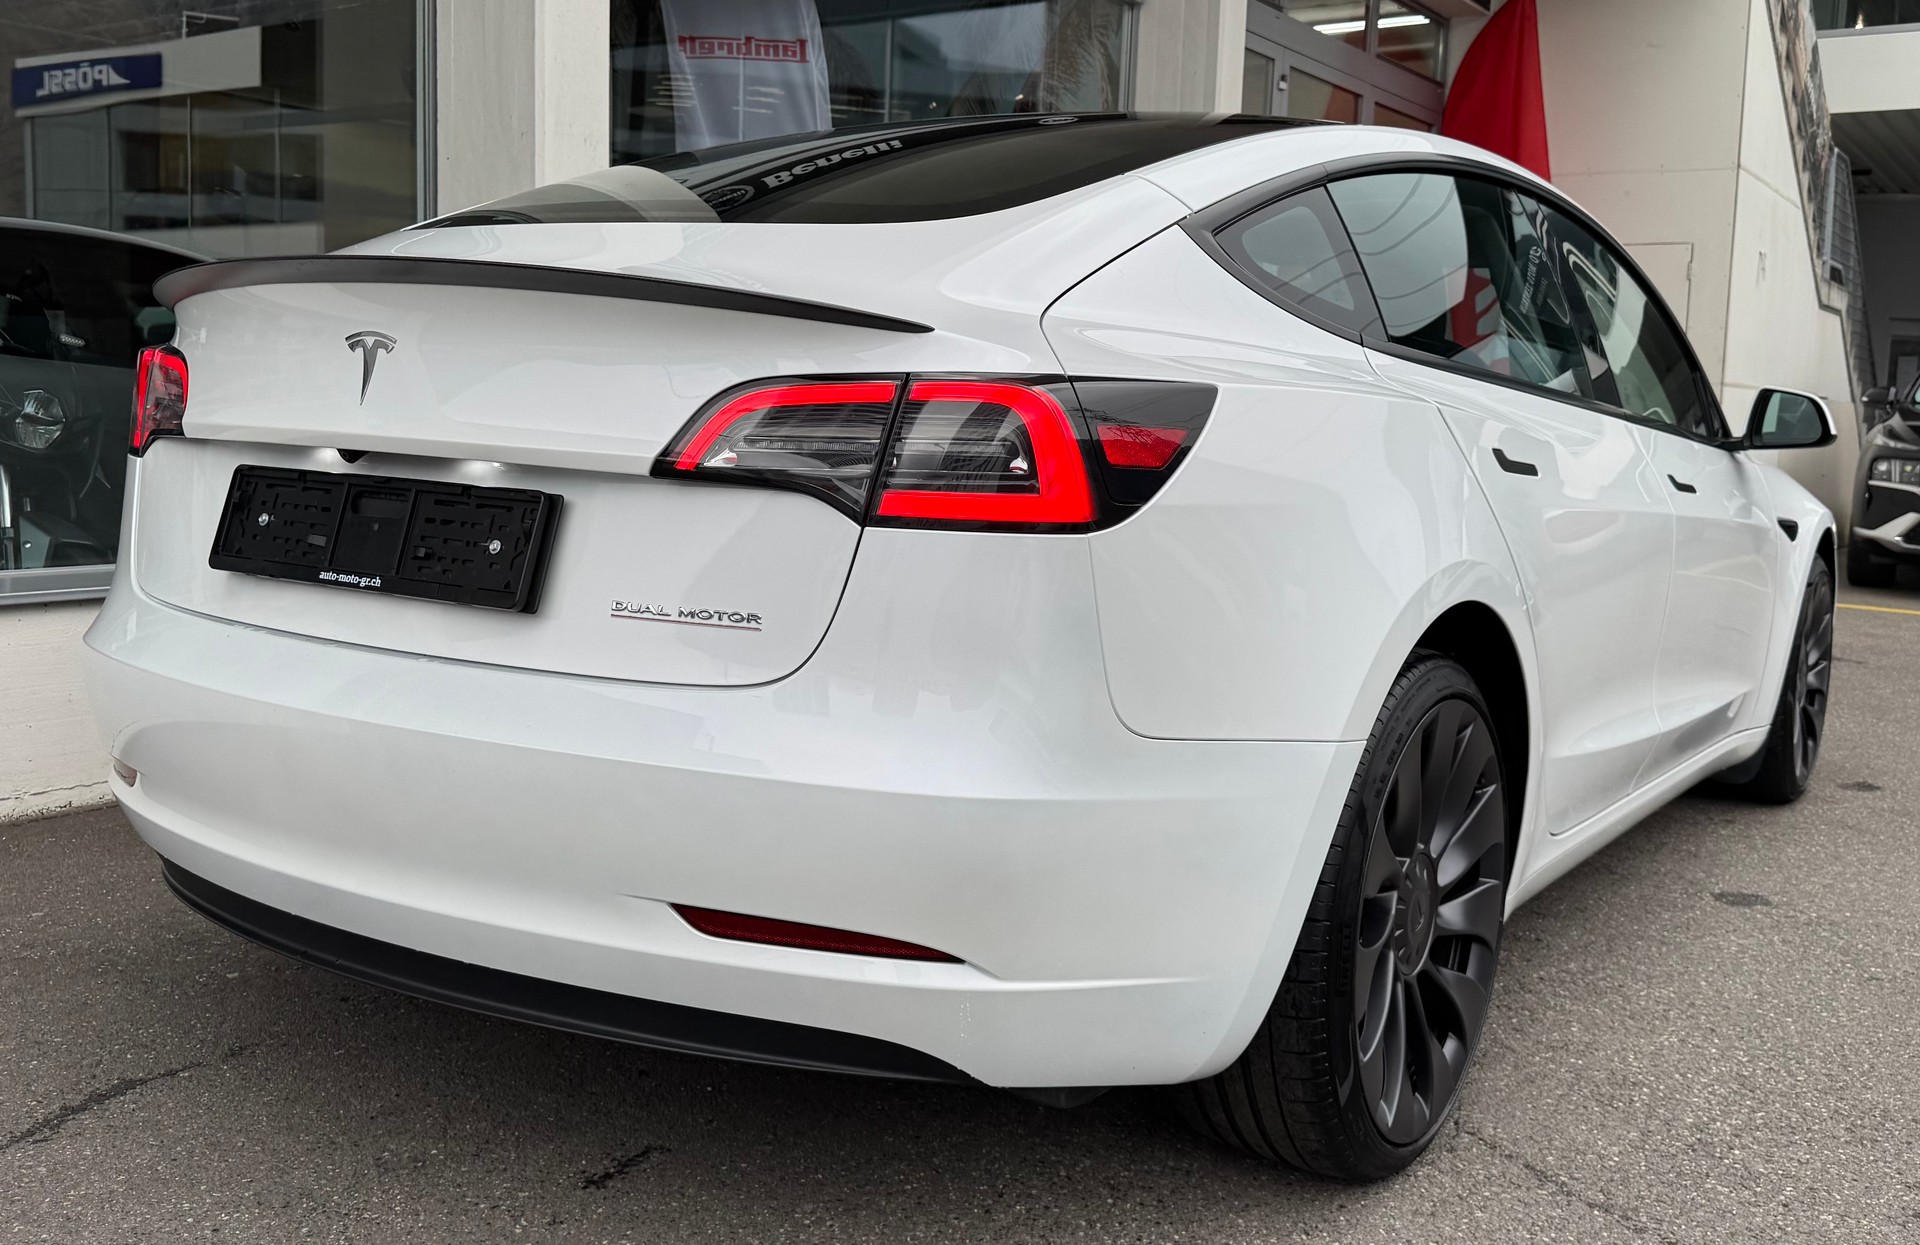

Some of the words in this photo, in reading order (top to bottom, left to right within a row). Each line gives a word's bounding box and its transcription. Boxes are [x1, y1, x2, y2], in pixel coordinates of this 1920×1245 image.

[318, 571, 382, 588] auto-moto-gr.ch
[611, 600, 672, 617] DUAL
[678, 606, 763, 625] MOTOR
